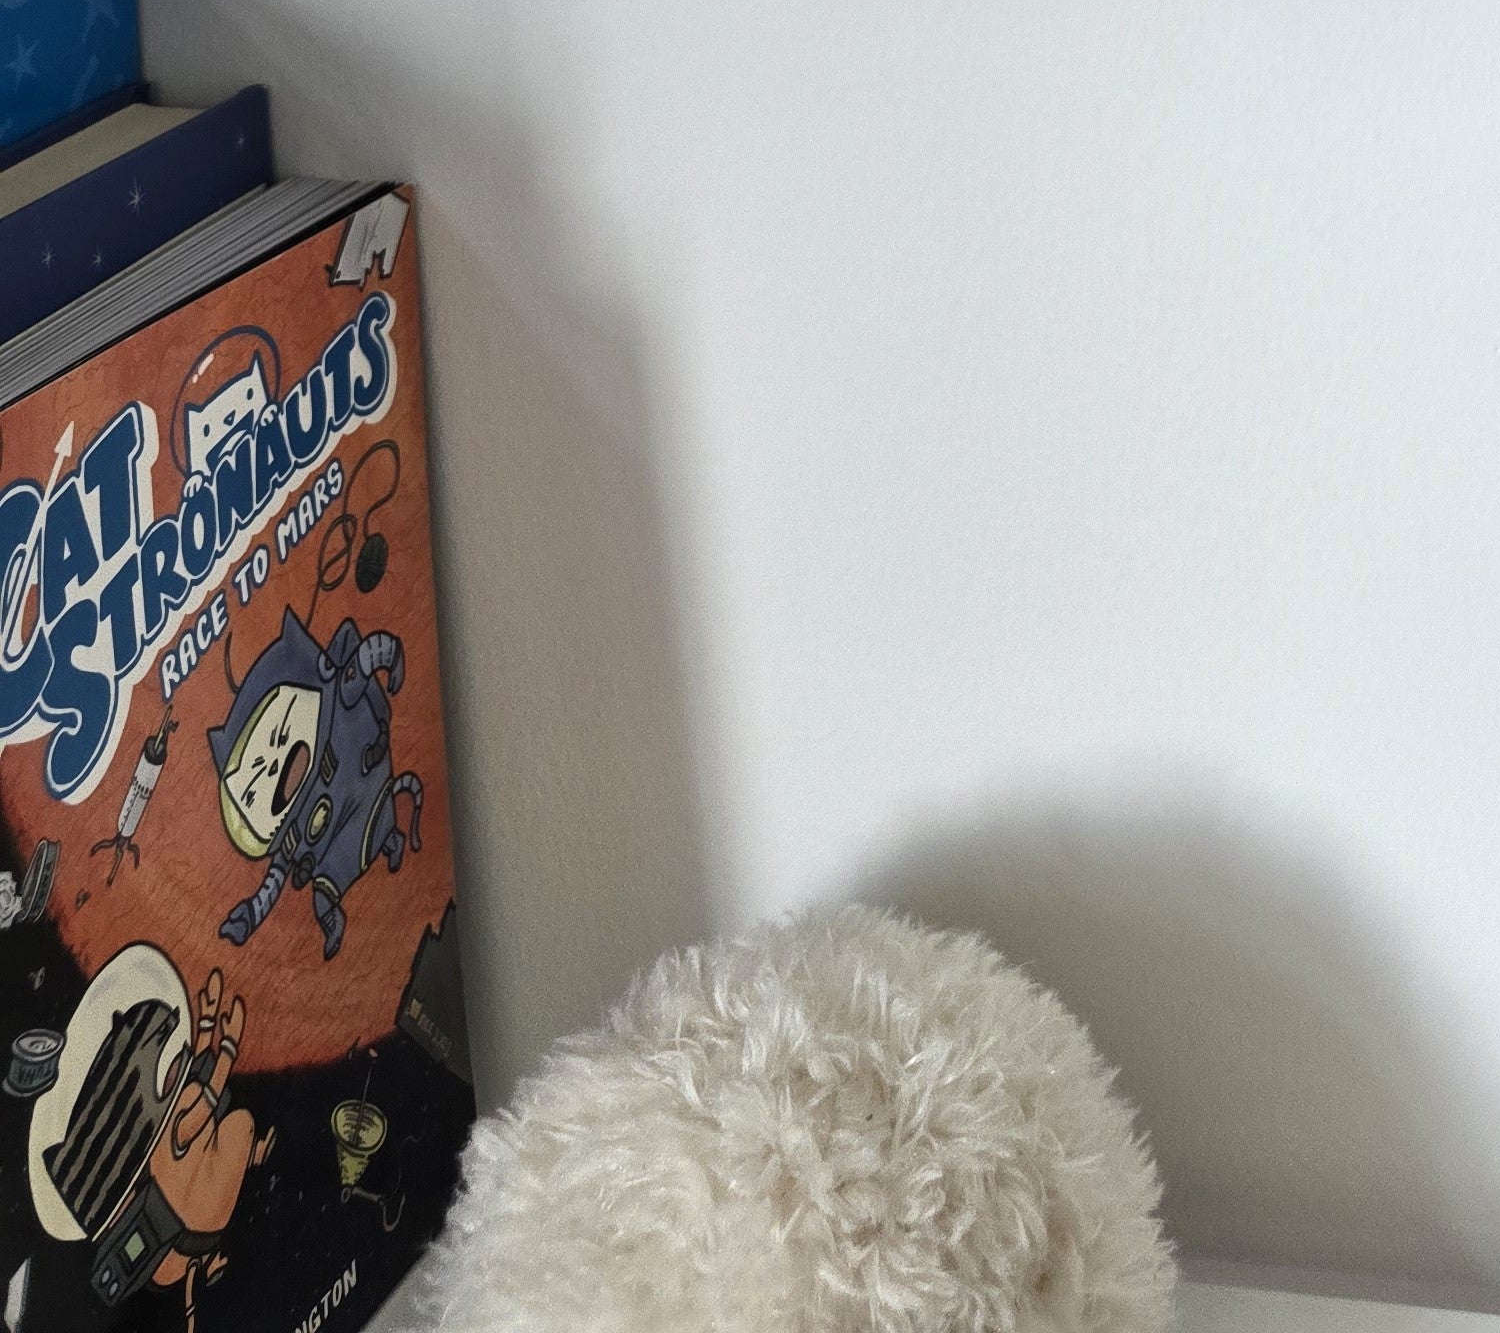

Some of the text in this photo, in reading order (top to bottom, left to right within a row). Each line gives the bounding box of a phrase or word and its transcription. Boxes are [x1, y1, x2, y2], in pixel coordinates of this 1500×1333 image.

[46, 294, 391, 798] STRONAUTS
[161, 460, 343, 700] RACE TO MARS
